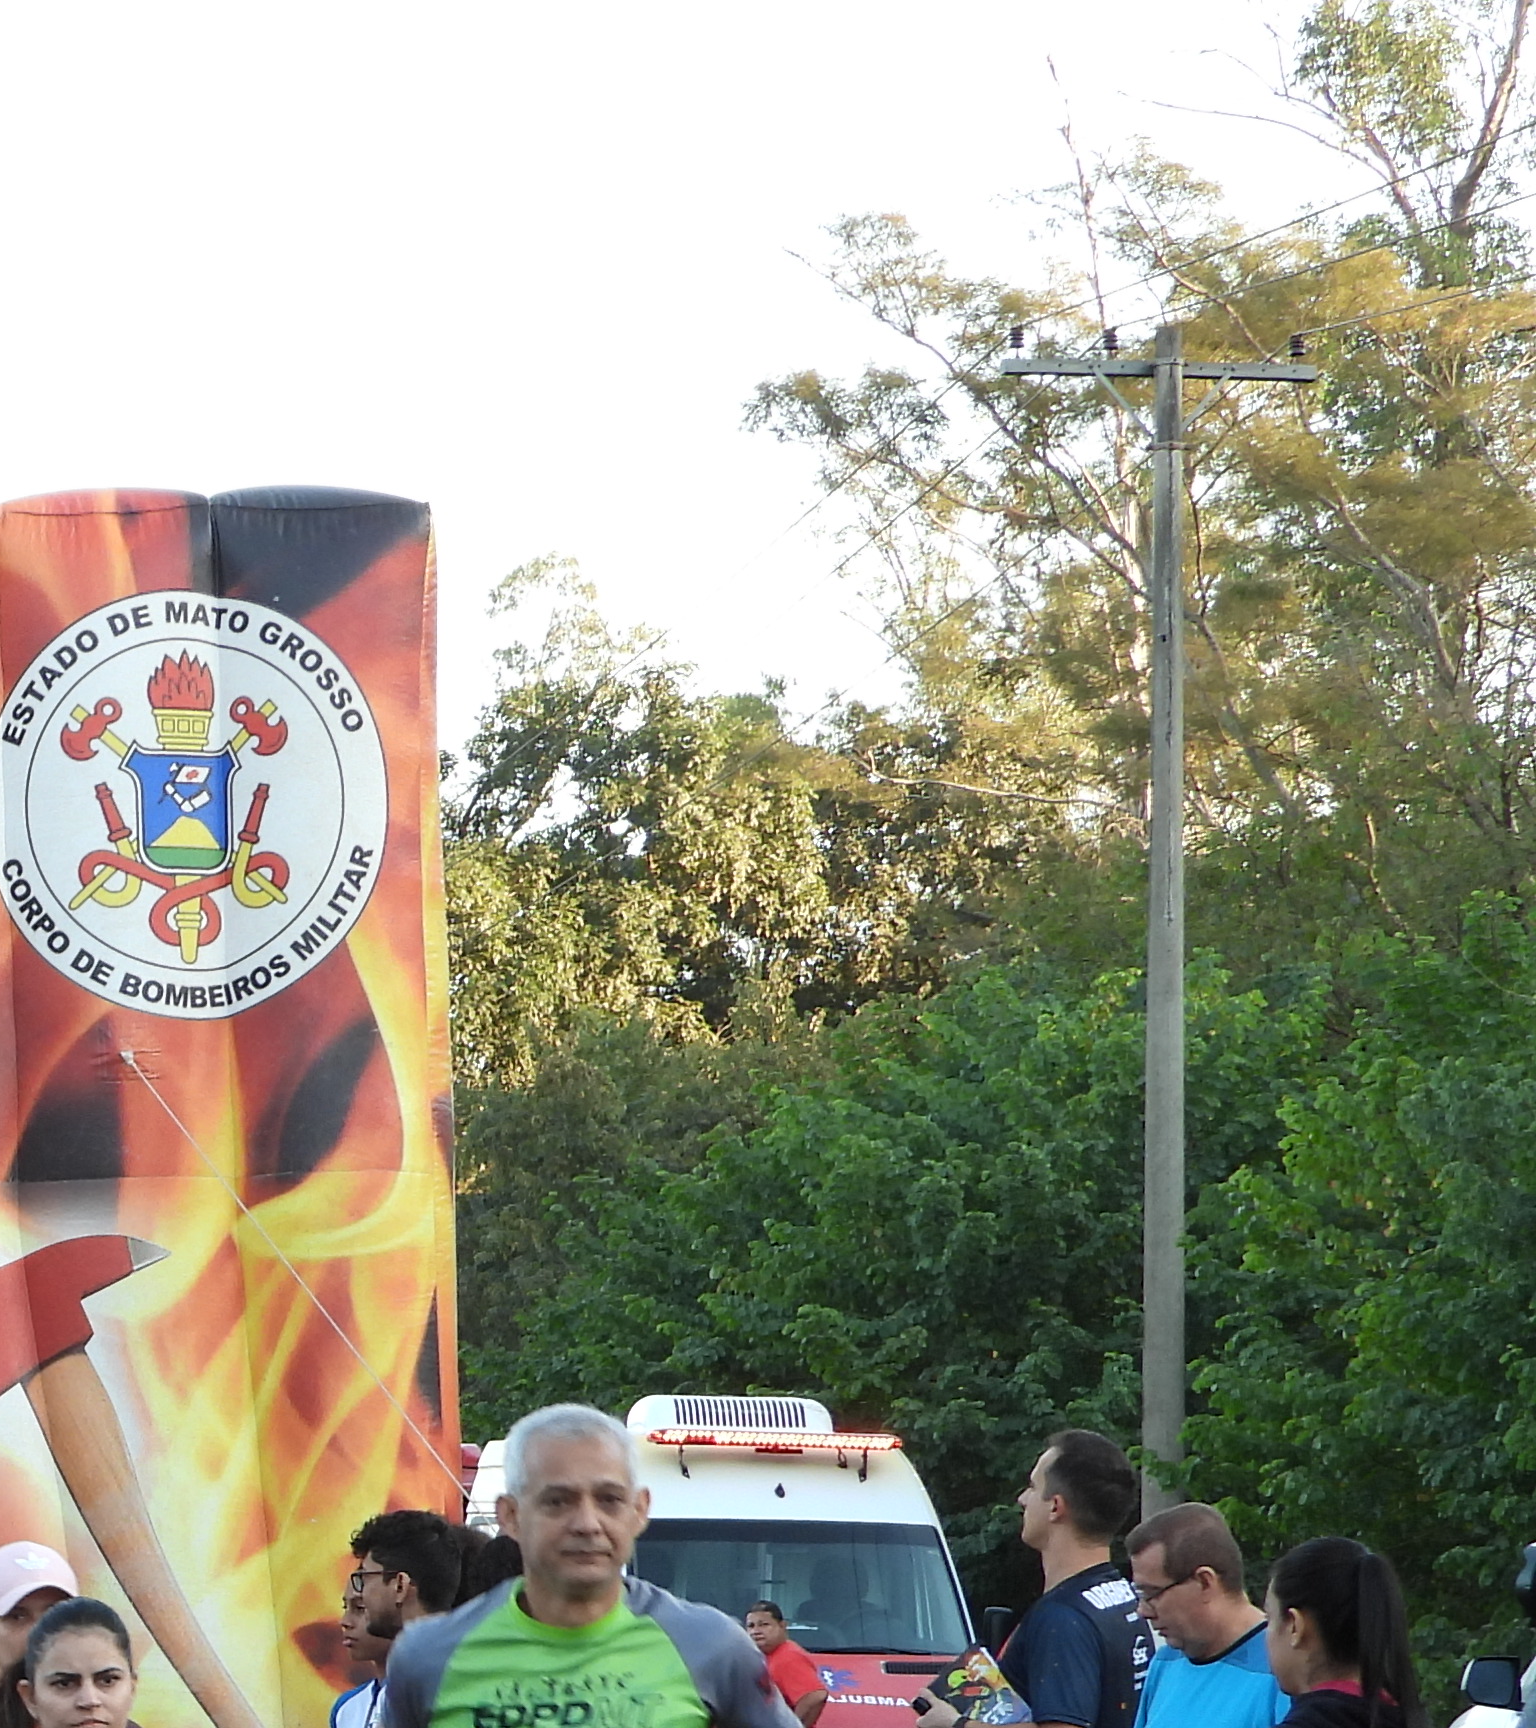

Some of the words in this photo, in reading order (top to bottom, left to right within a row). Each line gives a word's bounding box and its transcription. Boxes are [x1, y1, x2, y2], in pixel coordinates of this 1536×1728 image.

[2, 629, 100, 747] ESTADO
[106, 605, 154, 637] DE
[164, 601, 250, 634] MATO
[258, 622, 364, 733] GROSSO
[2, 858, 71, 954] CORPO
[70, 949, 115, 987] DE
[118, 954, 292, 1009] BOMBEIROS
[290, 844, 374, 962] MILITAR
